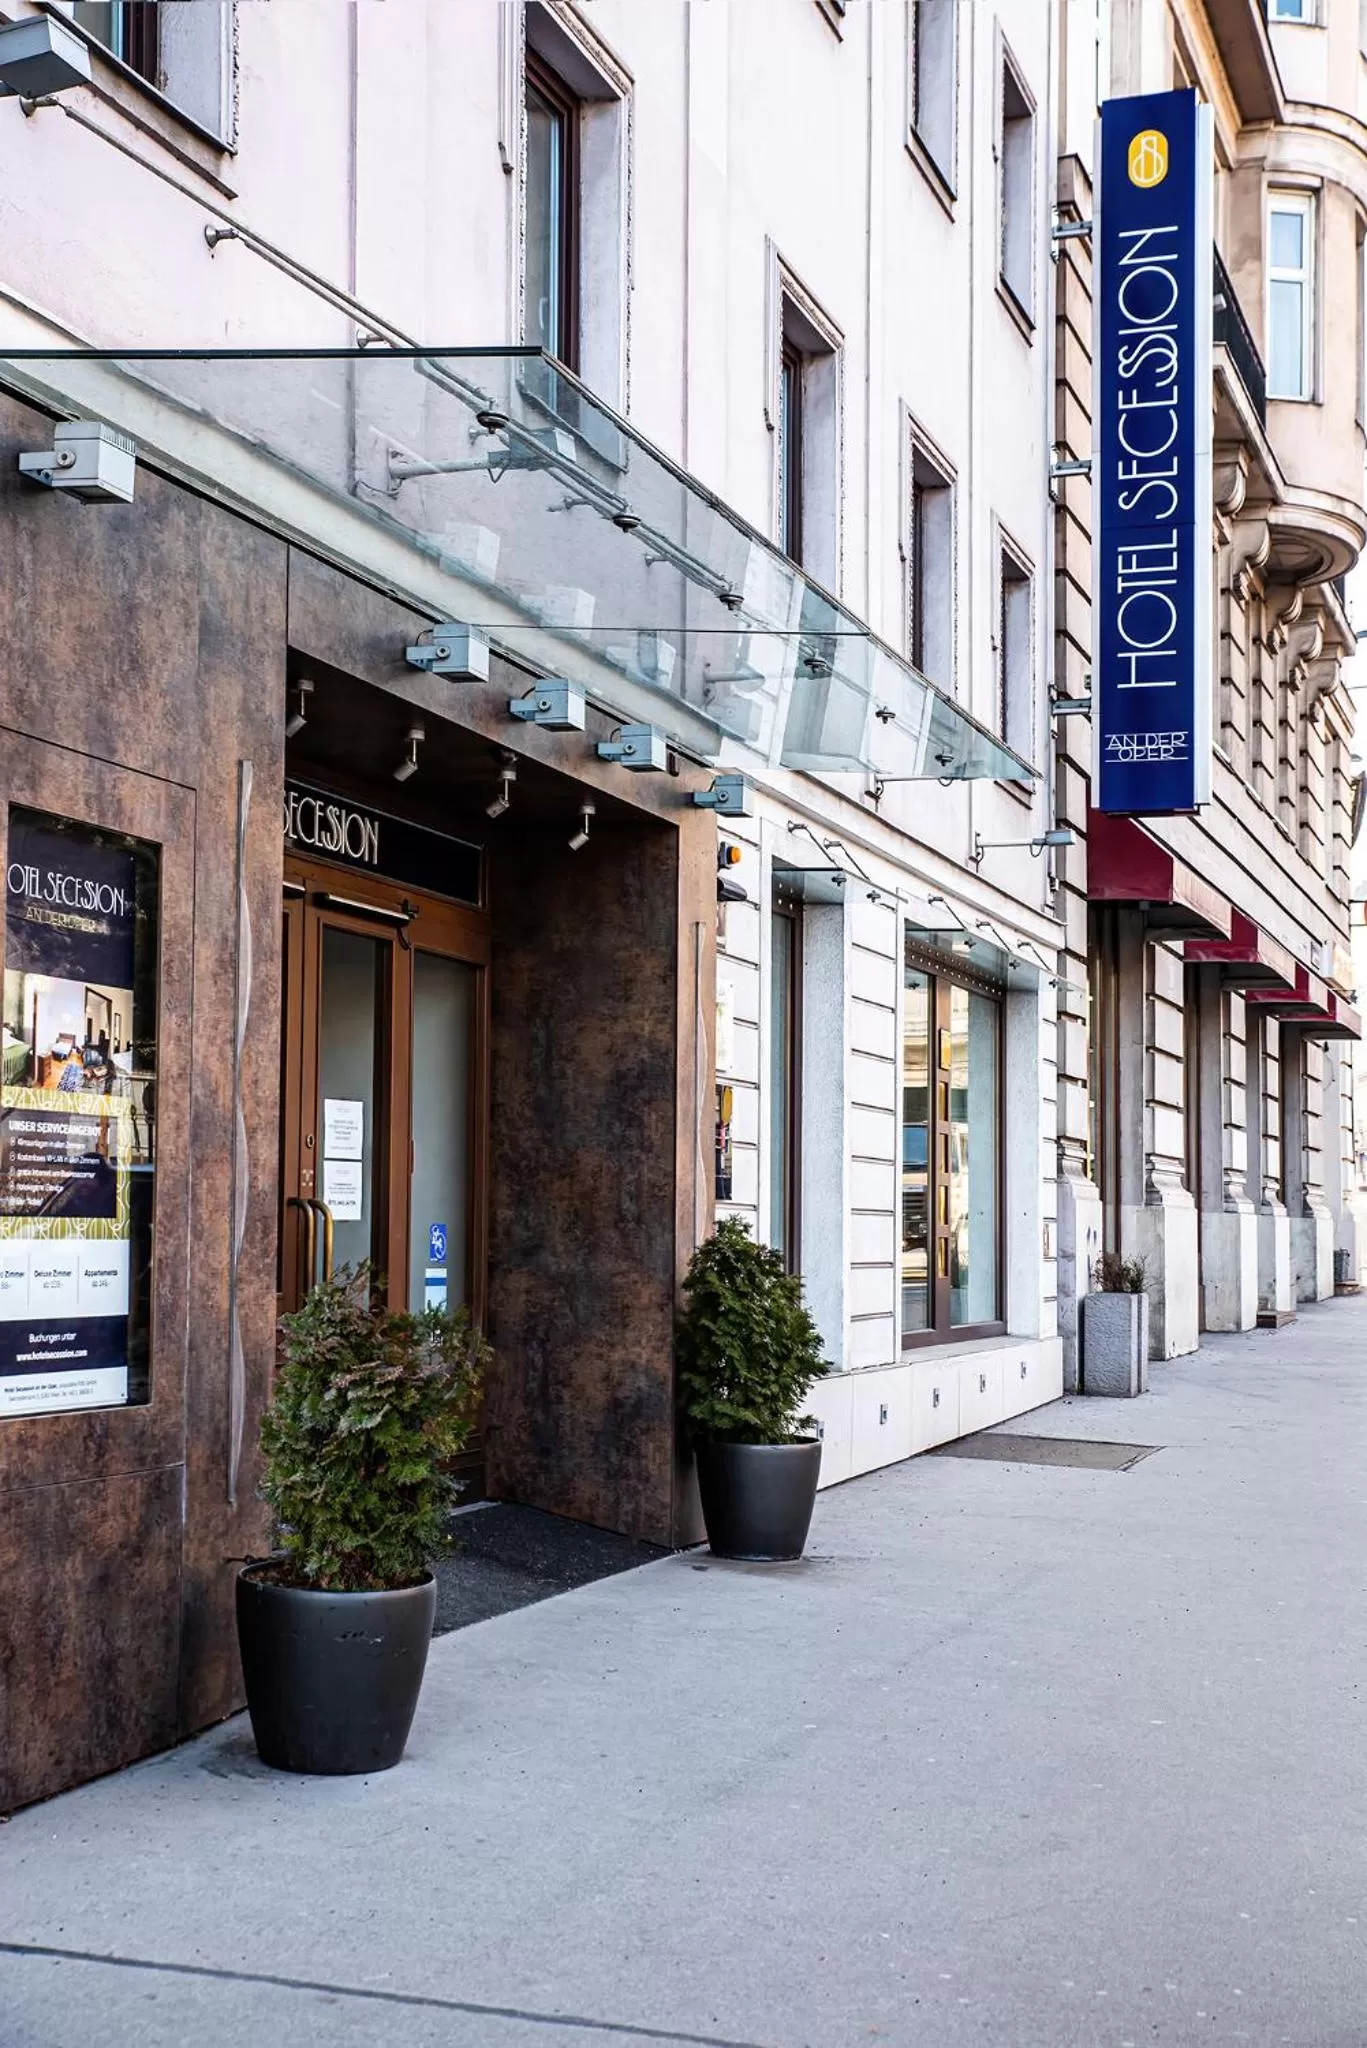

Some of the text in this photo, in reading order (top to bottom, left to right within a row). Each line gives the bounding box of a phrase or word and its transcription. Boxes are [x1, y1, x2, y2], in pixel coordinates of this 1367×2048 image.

[1117, 225, 1178, 689] HOTEL SECESSION
[1108, 732, 1186, 749] AN DER
[1118, 748, 1175, 761] OPER
[44, 871, 125, 917] SECESSION
[9, 1120, 36, 1132] UNSER
[28, 1333, 60, 1344] Buchungen
